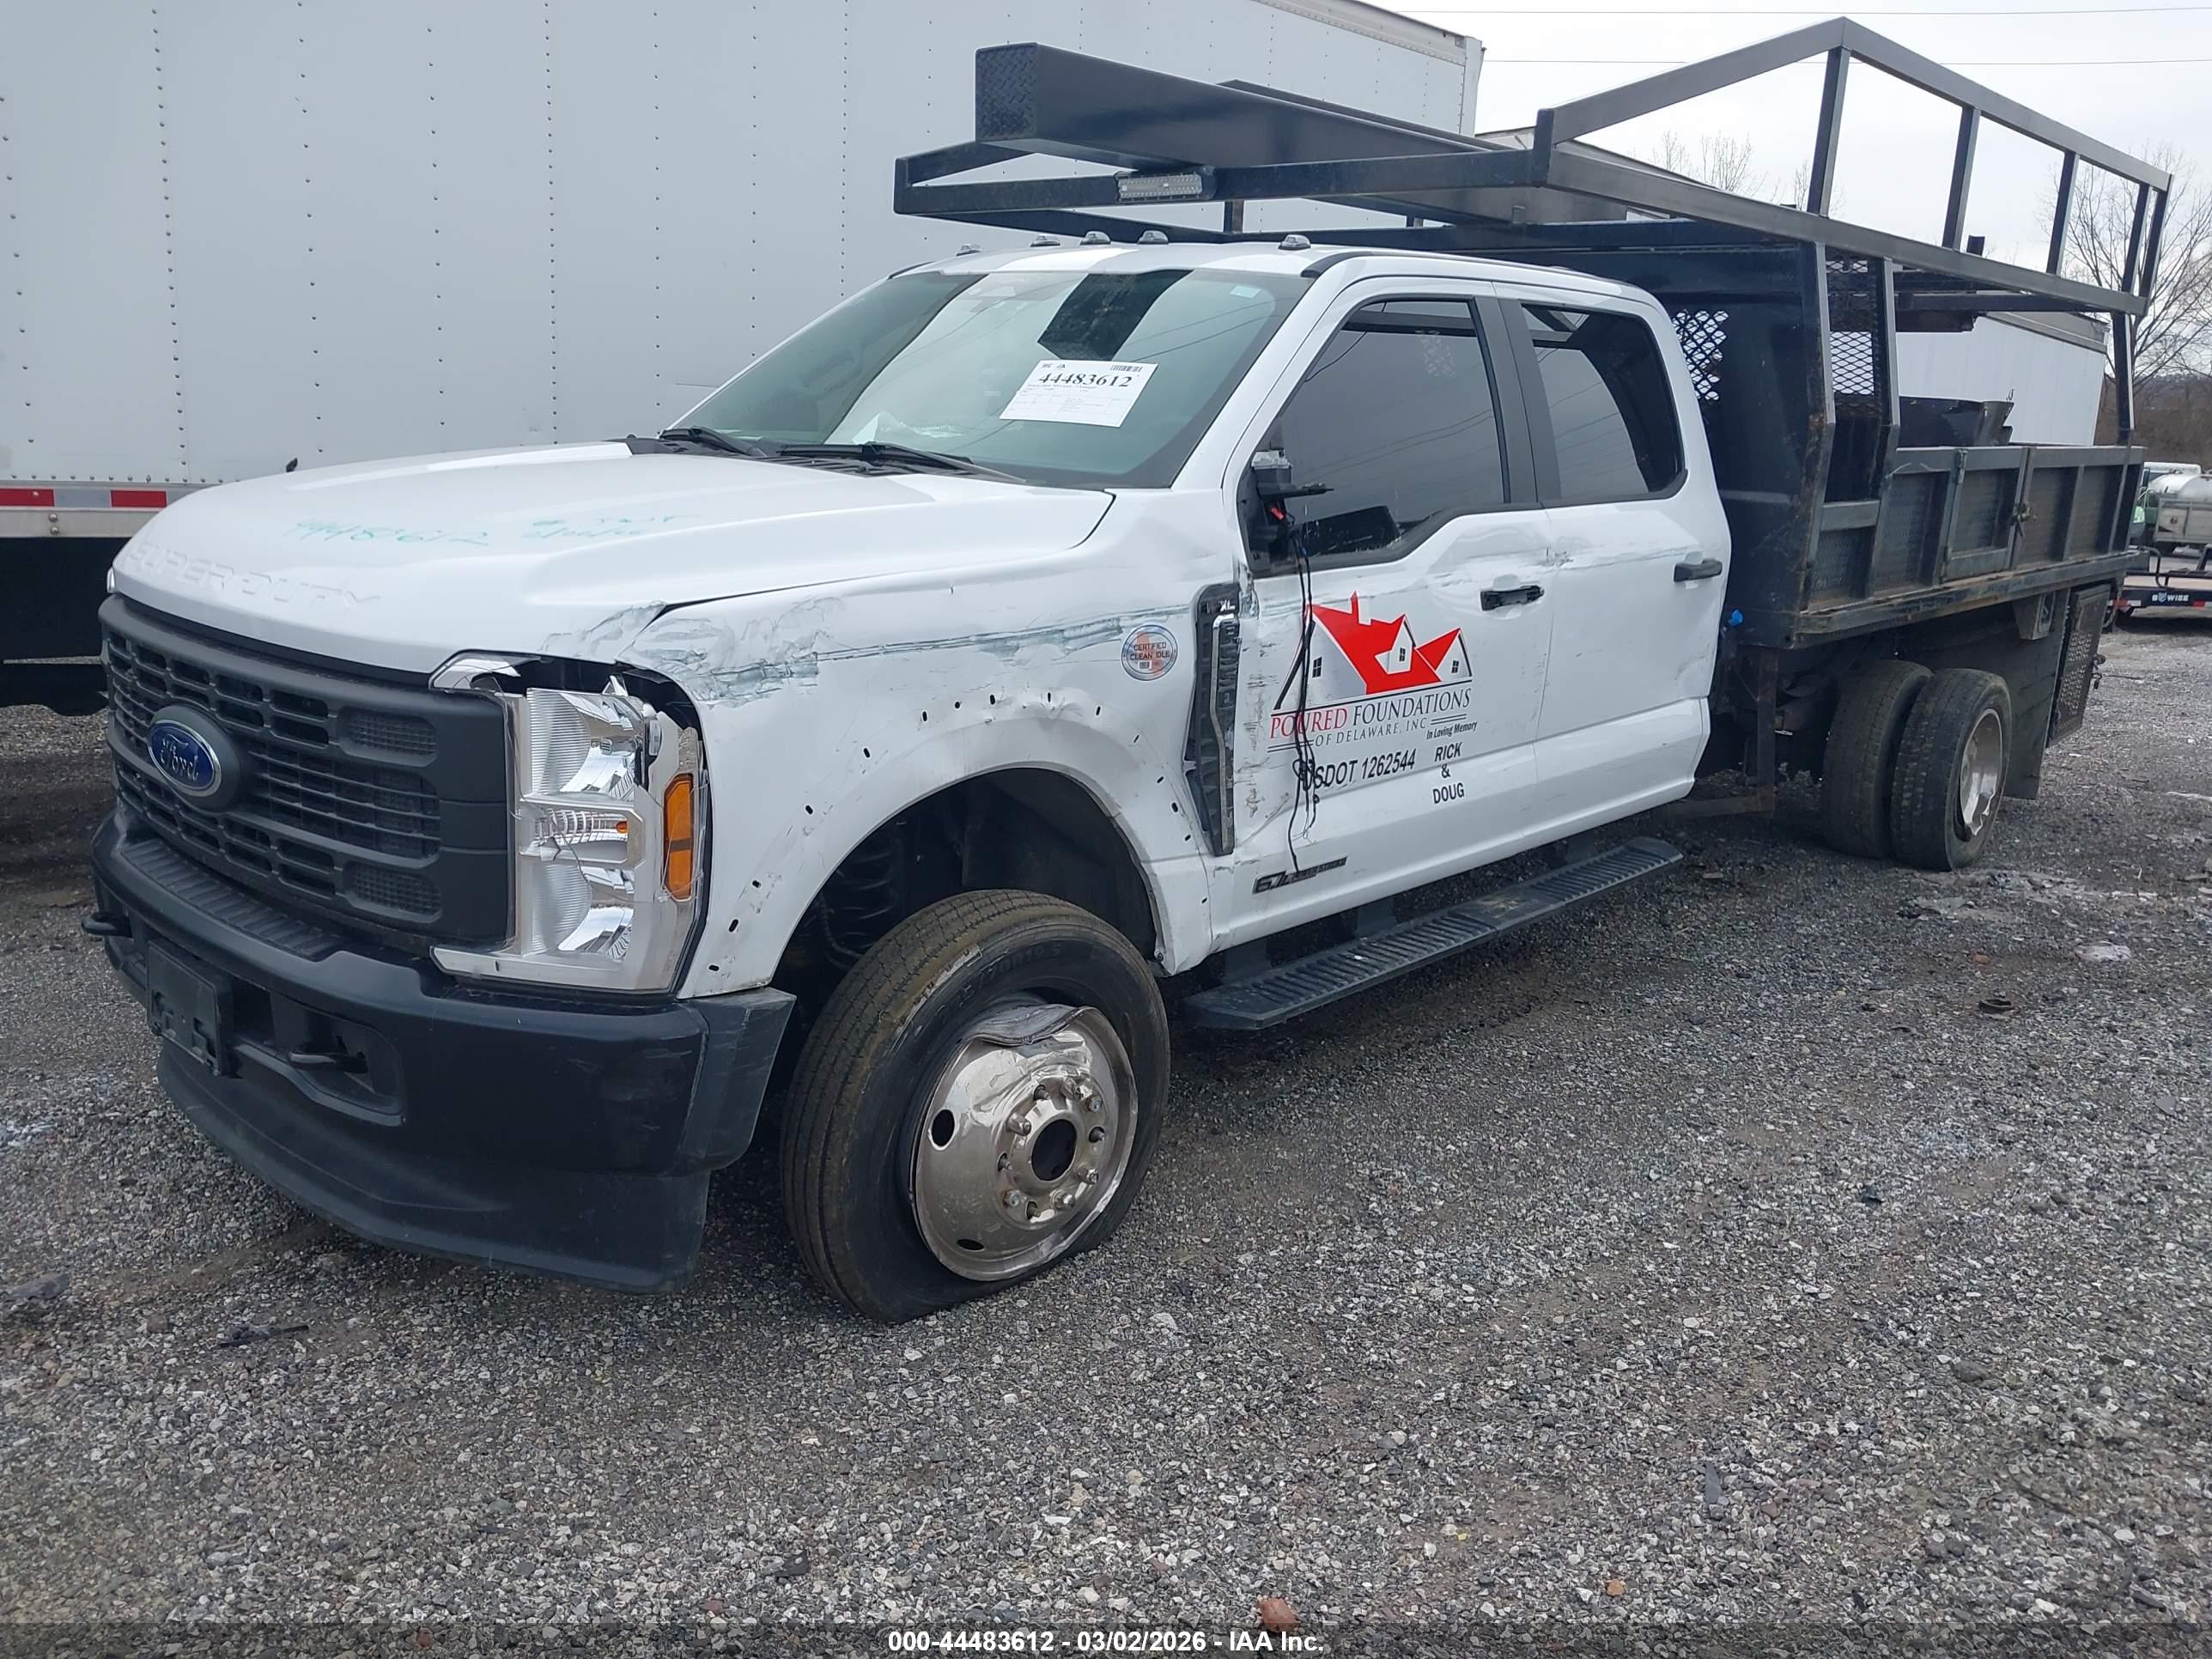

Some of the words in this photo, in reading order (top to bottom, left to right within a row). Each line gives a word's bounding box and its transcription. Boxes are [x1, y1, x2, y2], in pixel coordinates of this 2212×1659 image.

[1038, 372, 1133, 387] 44483612
[128, 541, 235, 590] SUPER
[240, 570, 384, 612] DUTY
[1220, 600, 1236, 611] XL
[1133, 641, 1167, 652] CERTIFIED
[1129, 653, 1153, 661] CLEAN
[1155, 650, 1170, 659] IDLE
[1270, 707, 1348, 739] POURED
[1352, 688, 1472, 726] FOUNDATIONS
[1426, 730, 1433, 739] In
[1434, 726, 1454, 738] Loving
[1454, 722, 1477, 734] Memory
[1315, 734, 1332, 747] OF
[160, 732, 201, 782] Ford
[1434, 742, 1463, 763] RICK
[1362, 748, 1417, 778] 1262544
[1441, 764, 1451, 779] &
[1432, 781, 1465, 805] DOUG
